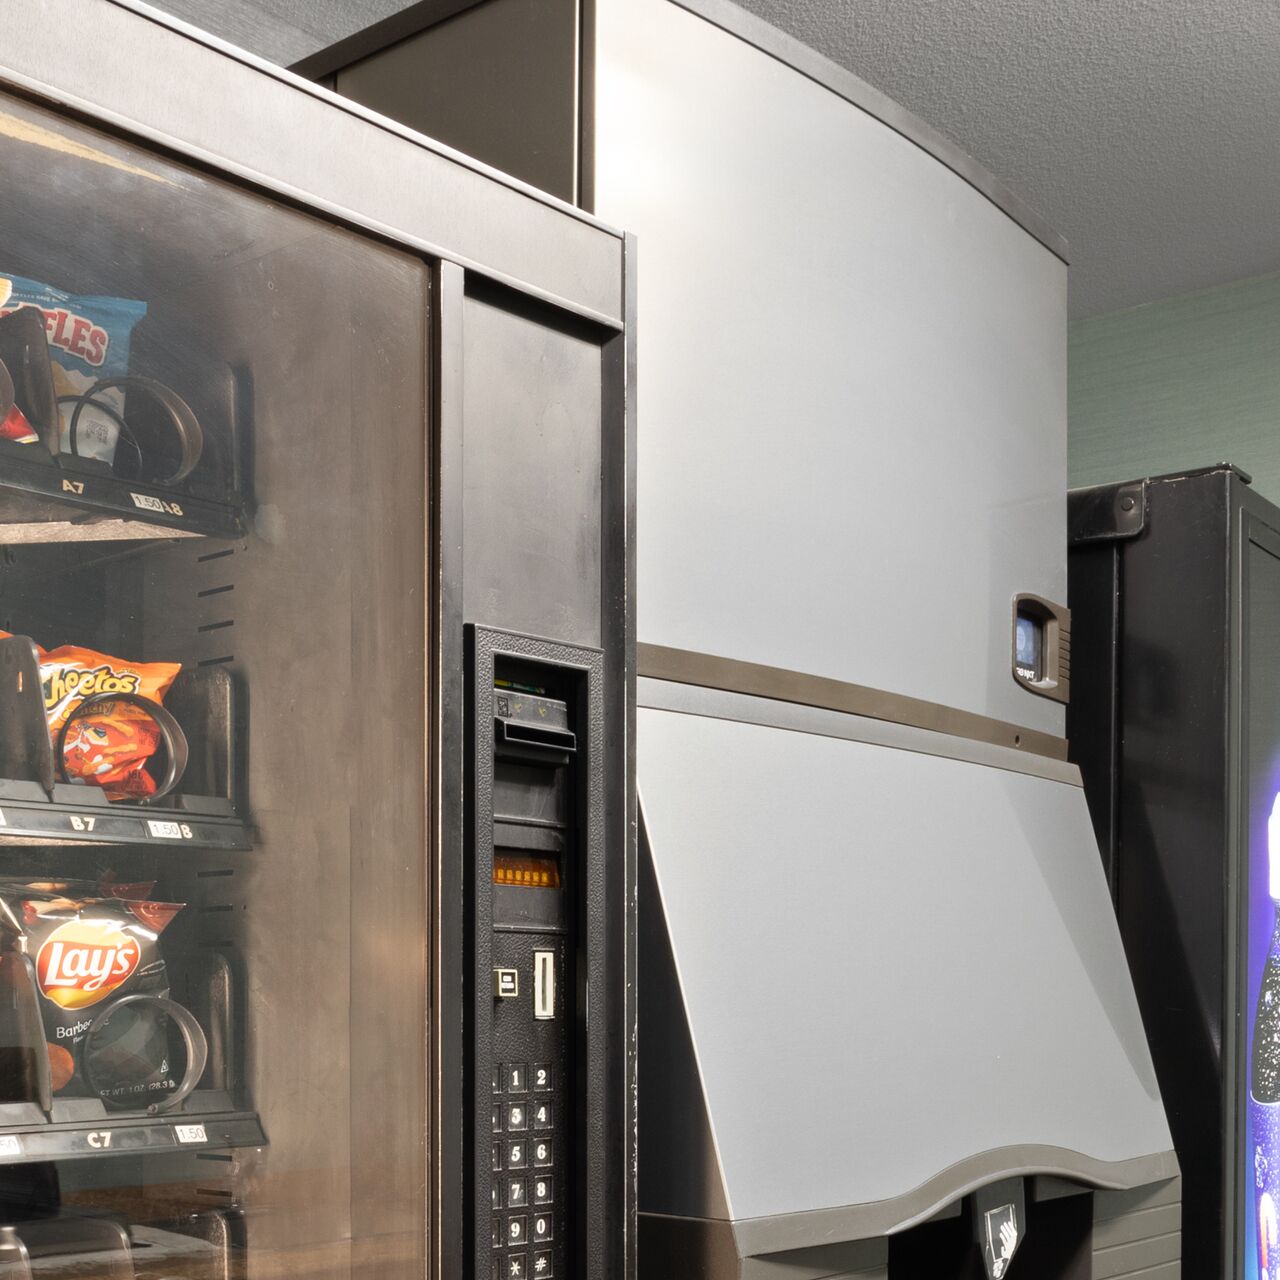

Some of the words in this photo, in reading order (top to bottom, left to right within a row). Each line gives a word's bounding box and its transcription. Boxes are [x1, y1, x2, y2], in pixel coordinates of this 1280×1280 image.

[62, 479, 84, 494] A7
[134, 494, 161, 511] 1.50
[70, 816, 95, 831] B7
[153, 823, 178, 836] 1.50
[43, 935, 135, 991] Lay's
[512, 1071, 520, 1086] 1
[537, 1070, 547, 1085] 2
[511, 1107, 521, 1124] 3
[537, 1107, 547, 1122] 4
[87, 1132, 111, 1148] C7
[179, 1128, 204, 1141] 1.50
[511, 1146, 521, 1162] 5
[537, 1145, 547, 1160] 6
[511, 1184, 521, 1200] 7
[537, 1182, 546, 1197] 8
[511, 1222, 521, 1238] 9
[536, 1219, 546, 1235] 0
